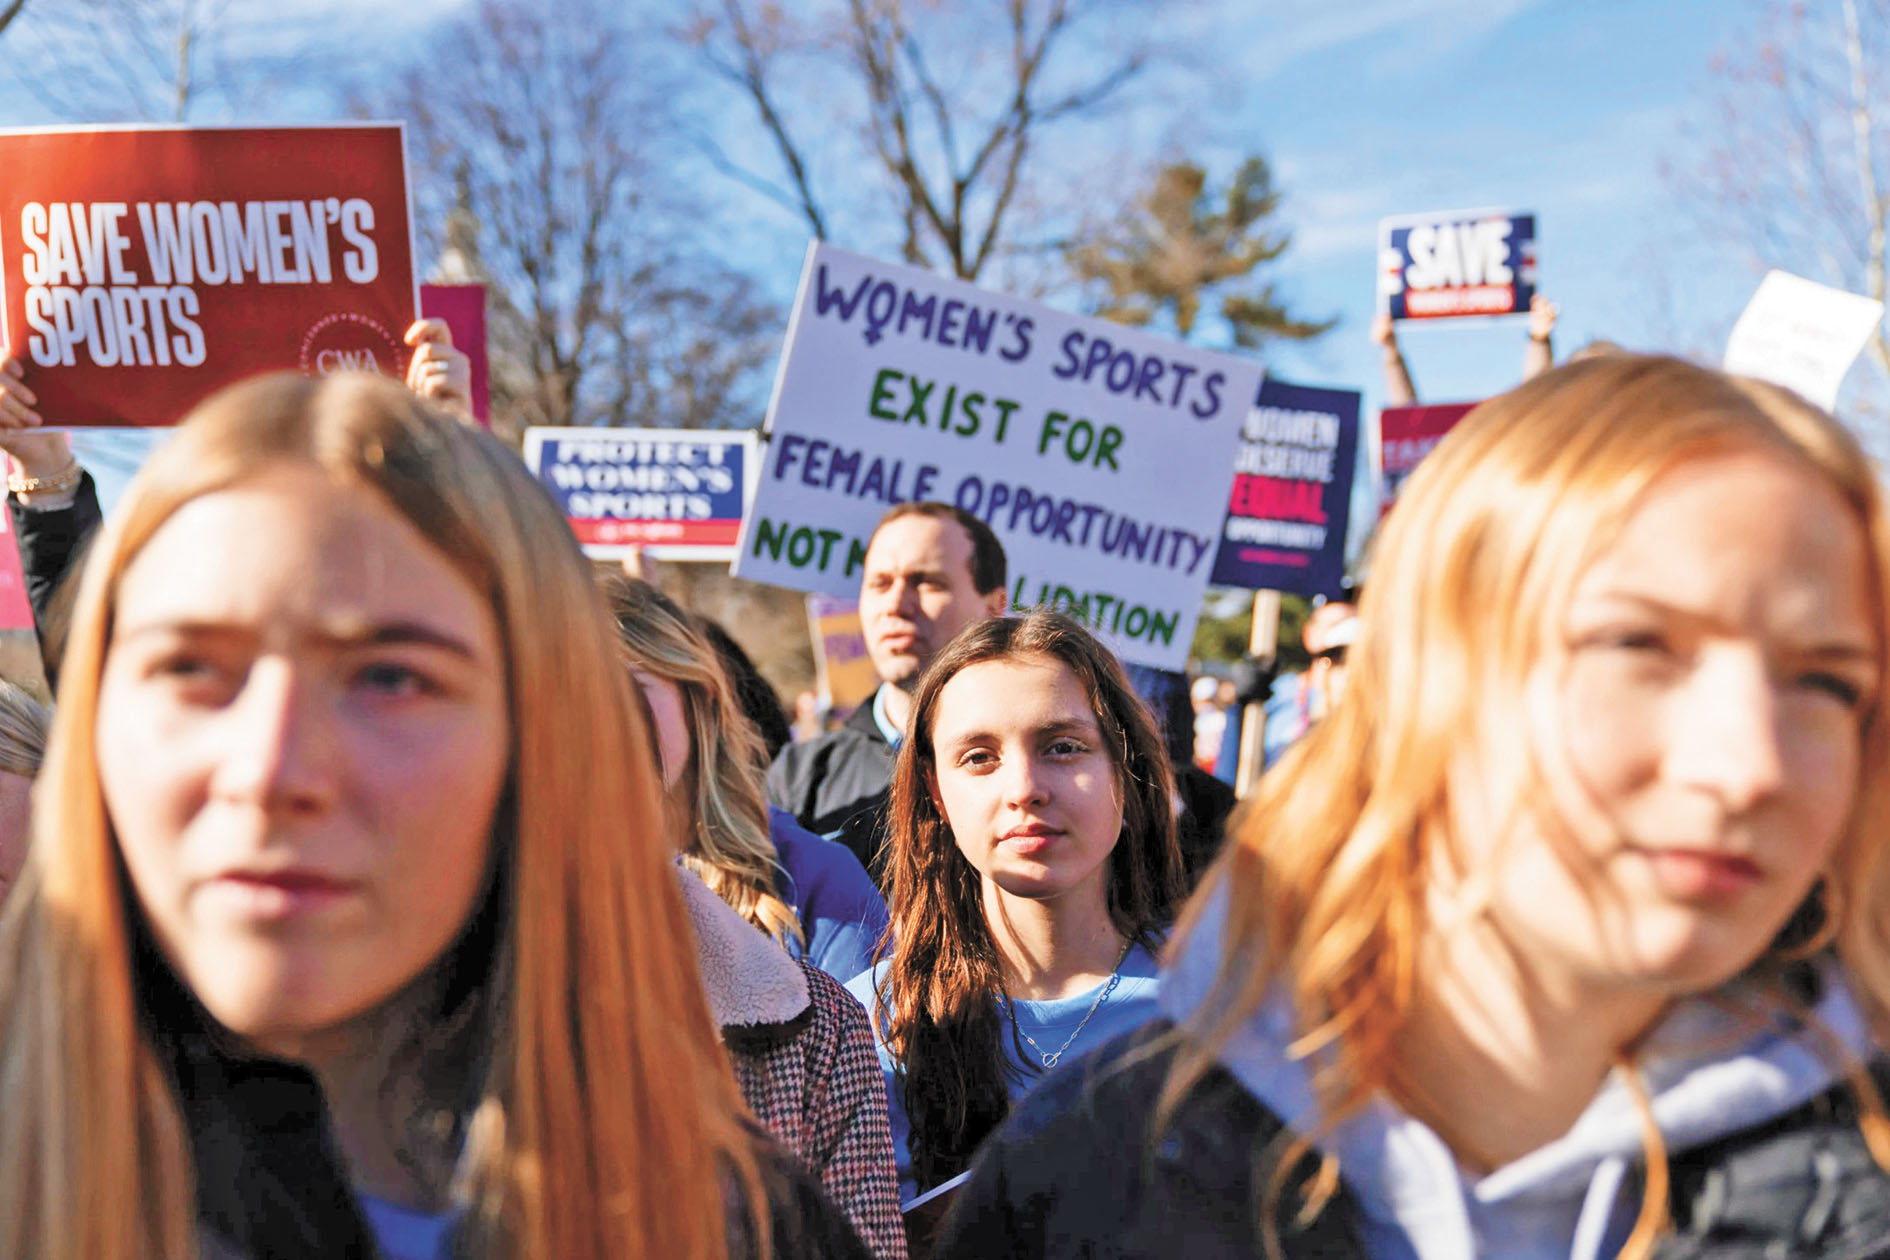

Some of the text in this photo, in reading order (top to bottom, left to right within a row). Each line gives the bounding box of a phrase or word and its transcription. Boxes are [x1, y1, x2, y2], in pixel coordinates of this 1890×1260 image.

[21, 197, 380, 286] SAVE WOMEN'S
[1405, 220, 1514, 290] SAVE
[25, 285, 207, 367] SPORTS
[316, 347, 381, 377] CWA
[816, 264, 1225, 419] WOMEN'S SPORTS
[556, 440, 726, 466] PROTECT
[869, 368, 1124, 471] EXIST FOR
[568, 490, 713, 519] SPORTS
[775, 434, 938, 504] FEMALE
[956, 475, 1211, 574] OPPORTUNITY
[1229, 472, 1329, 526] EQUAL
[753, 517, 843, 571] NOT
[1010, 575, 1180, 646] LIDATION
